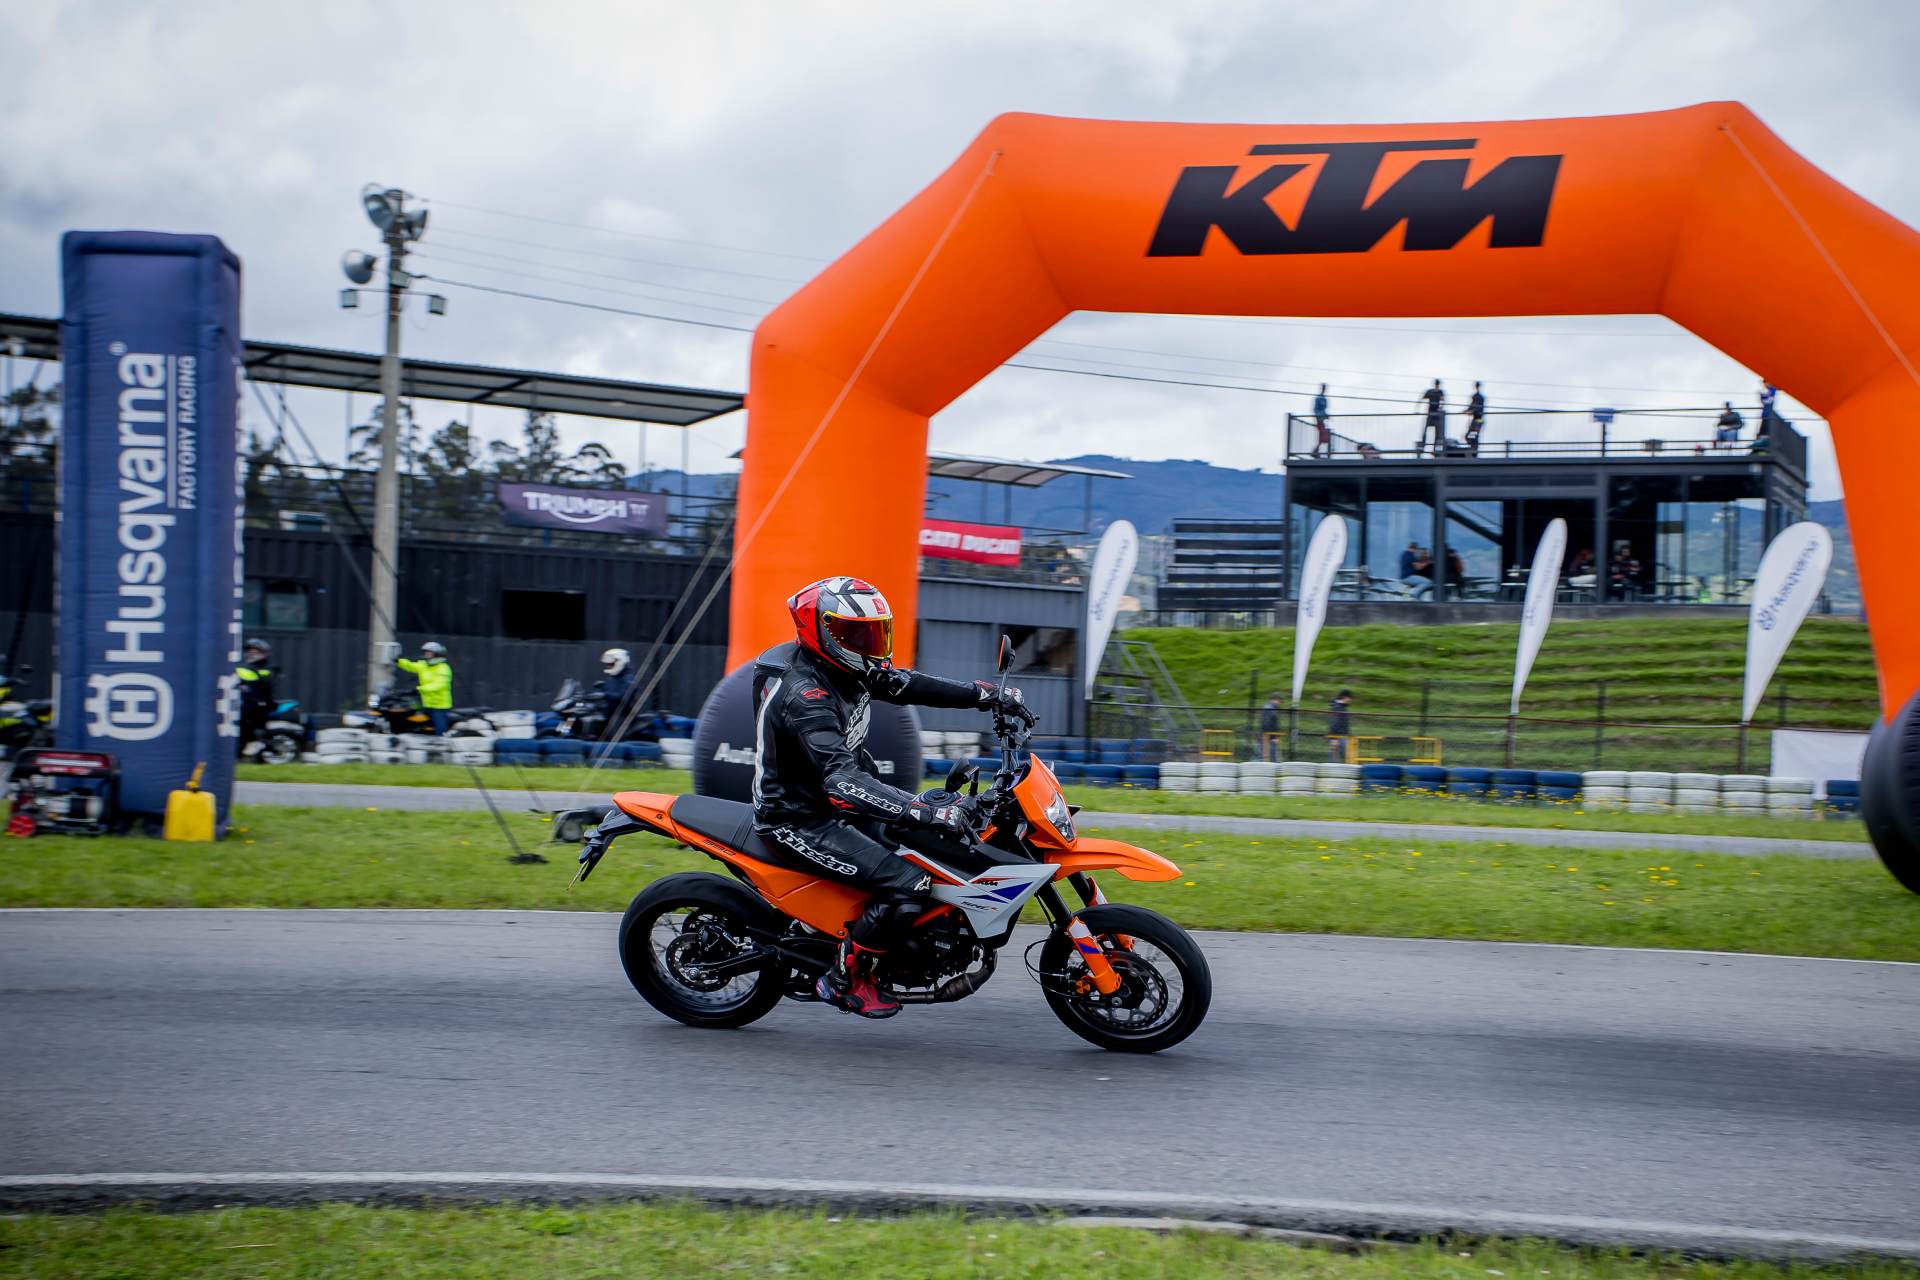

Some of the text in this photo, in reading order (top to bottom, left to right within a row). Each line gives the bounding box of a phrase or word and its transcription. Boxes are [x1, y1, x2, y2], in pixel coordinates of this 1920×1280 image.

[1145, 139, 1564, 257] KTM
[178, 355, 196, 509] FACTORY RACING
[106, 352, 175, 663] Husqvarna
[522, 491, 627, 523] TRIUMPH
[837, 781, 902, 814] alpinestars
